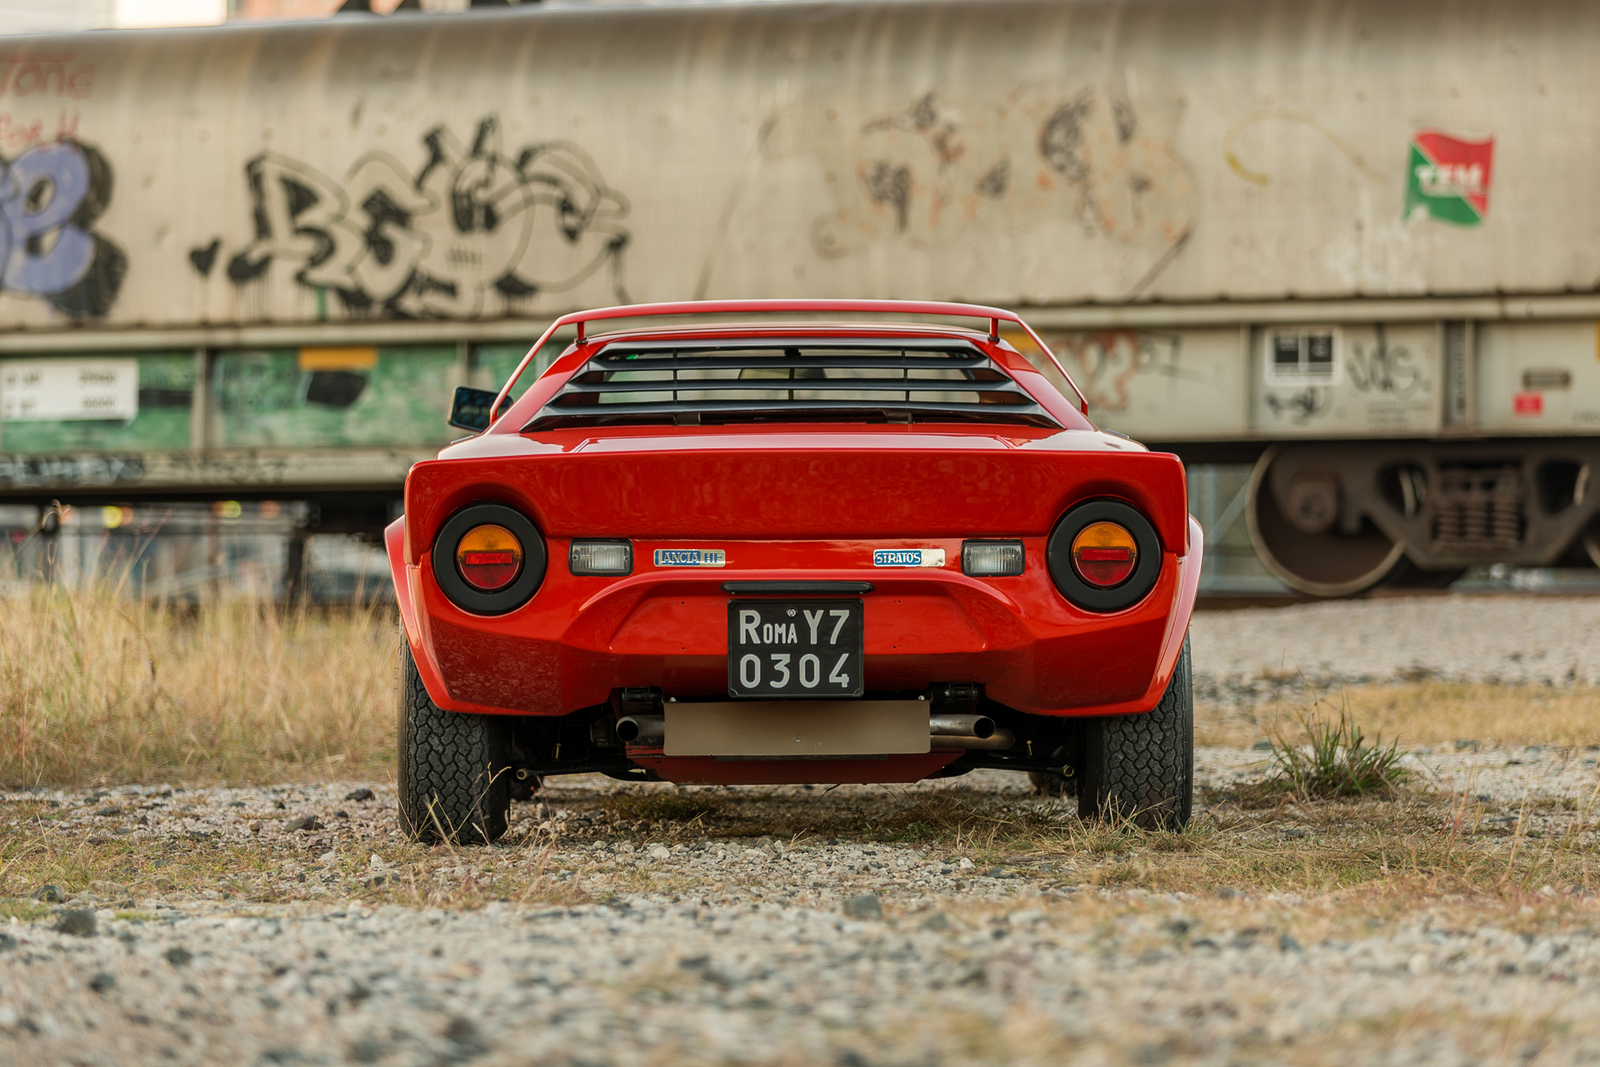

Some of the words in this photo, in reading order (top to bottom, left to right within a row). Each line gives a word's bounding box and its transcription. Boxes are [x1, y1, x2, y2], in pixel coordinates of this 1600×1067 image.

[656, 550, 701, 565] LANCIA
[703, 552, 724, 564] HF
[803, 609, 850, 645] Y7
[739, 653, 850, 688] 0304
